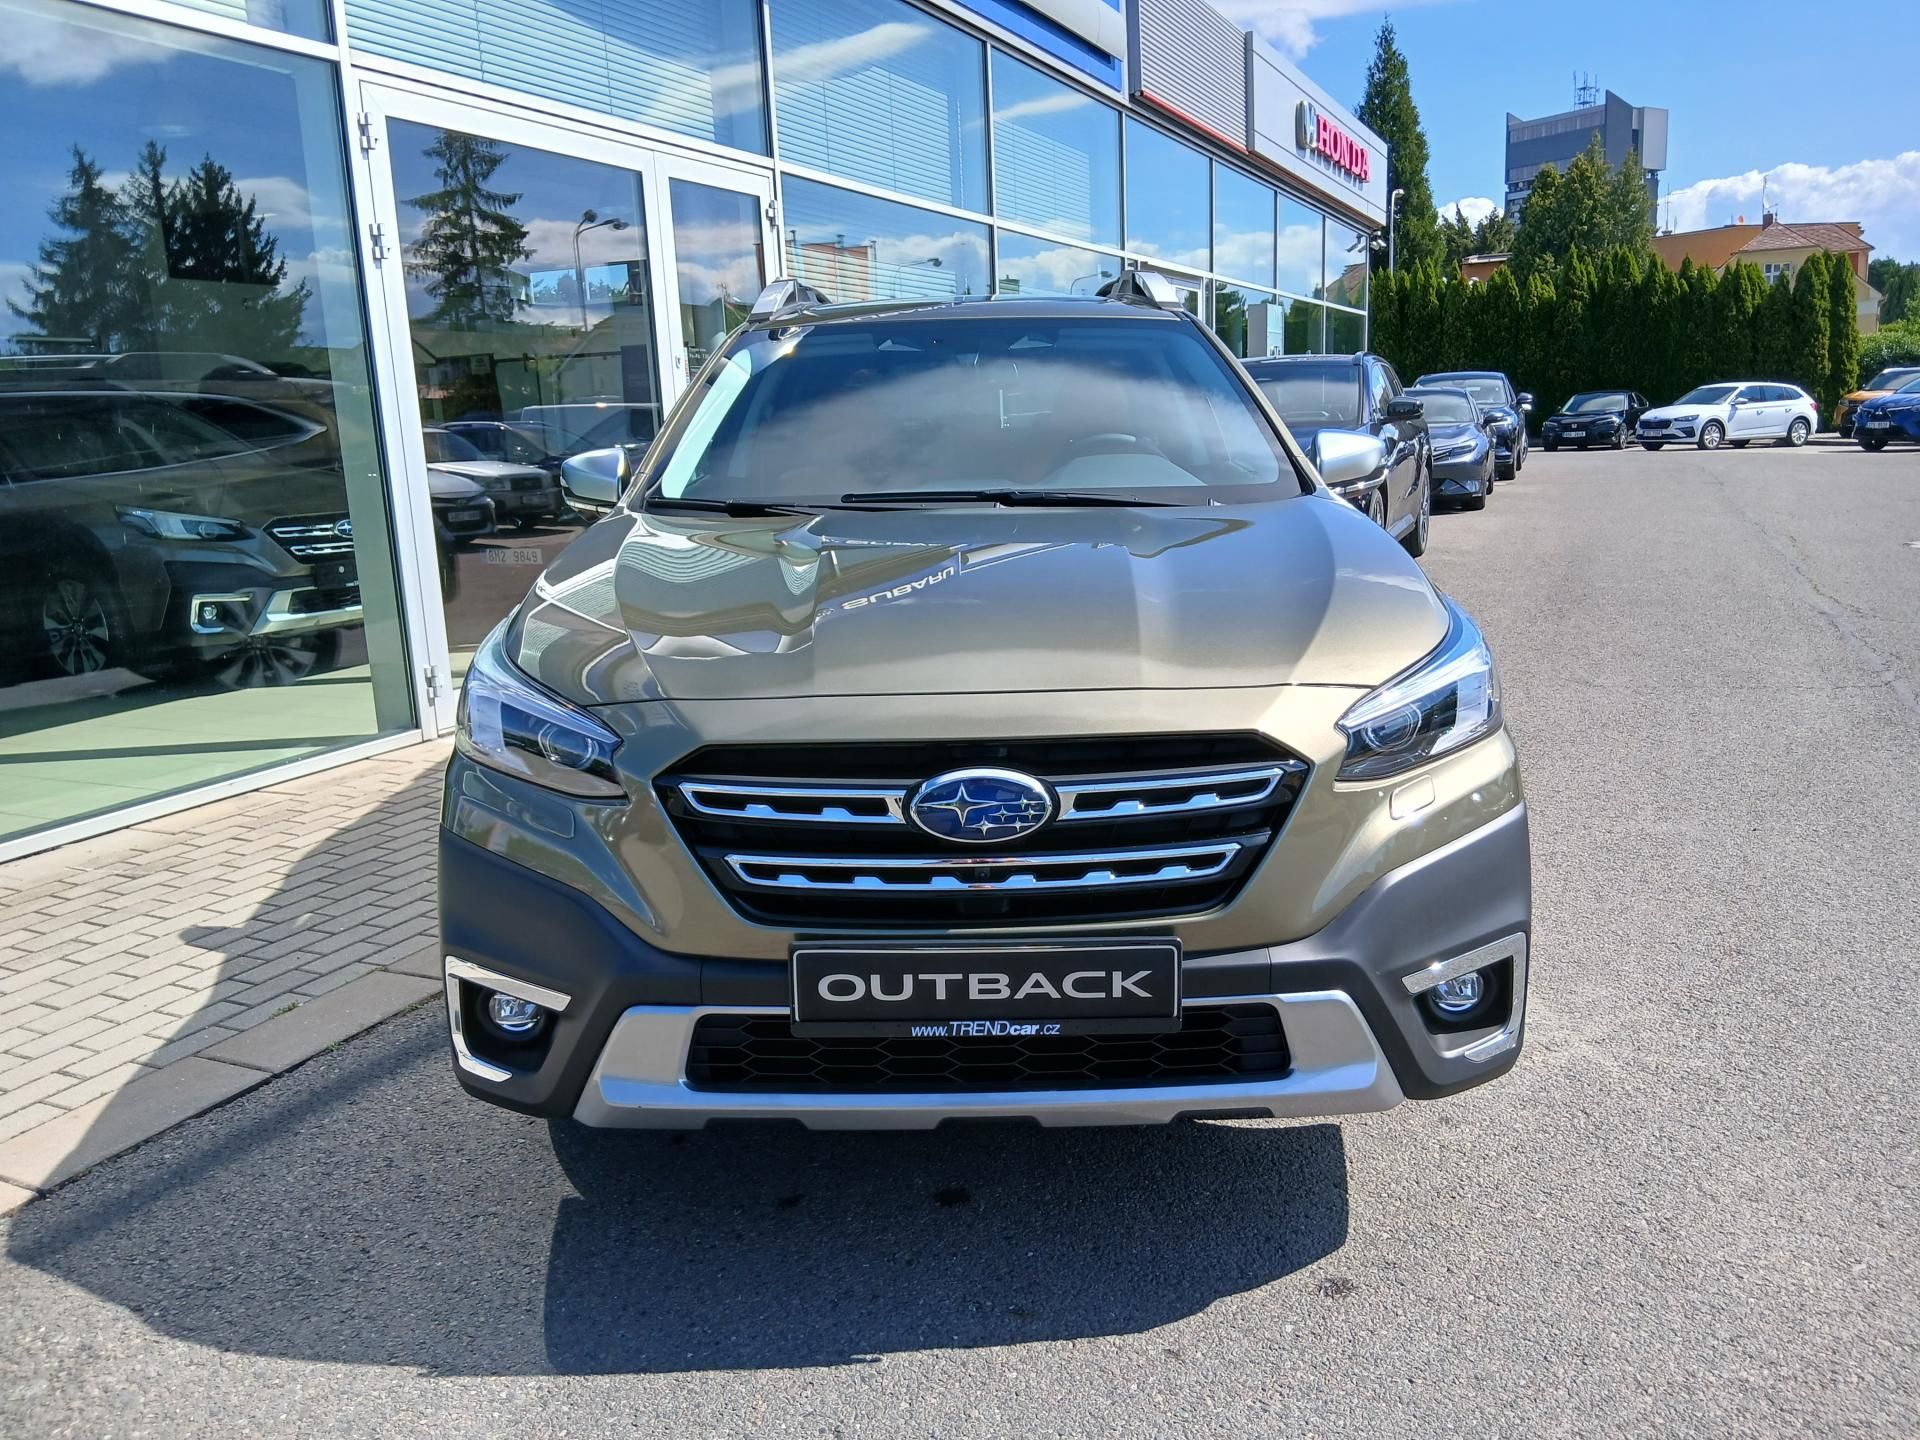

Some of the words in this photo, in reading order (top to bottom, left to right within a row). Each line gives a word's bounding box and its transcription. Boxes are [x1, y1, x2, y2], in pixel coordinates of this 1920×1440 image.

[1317, 113, 1370, 183] HONDA
[818, 970, 1153, 1001] OUTBACK
[911, 1020, 1061, 1037] www.TRENDcar.cz
